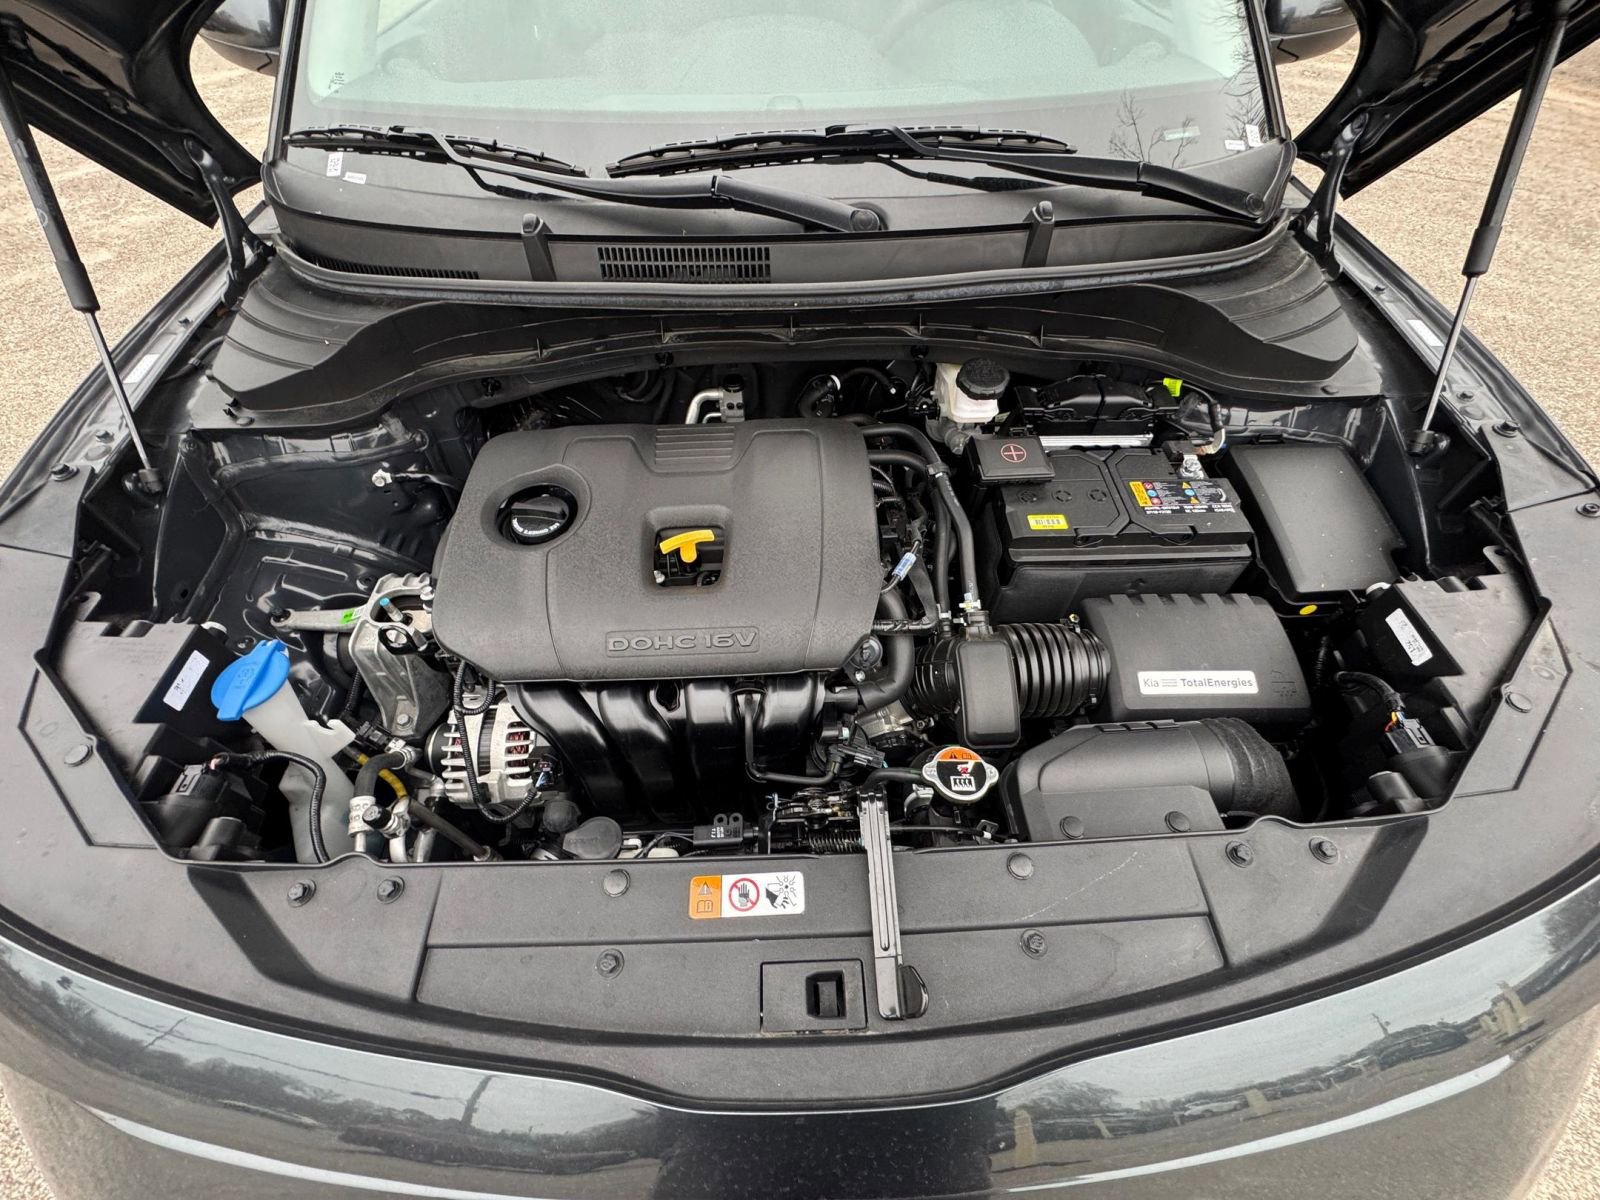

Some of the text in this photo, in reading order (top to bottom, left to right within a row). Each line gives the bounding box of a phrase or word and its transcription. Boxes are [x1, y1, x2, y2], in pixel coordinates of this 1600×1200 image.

[608, 632, 757, 652] DOHC 16V
[1143, 678, 1253, 689] Kia TotalEnergies
